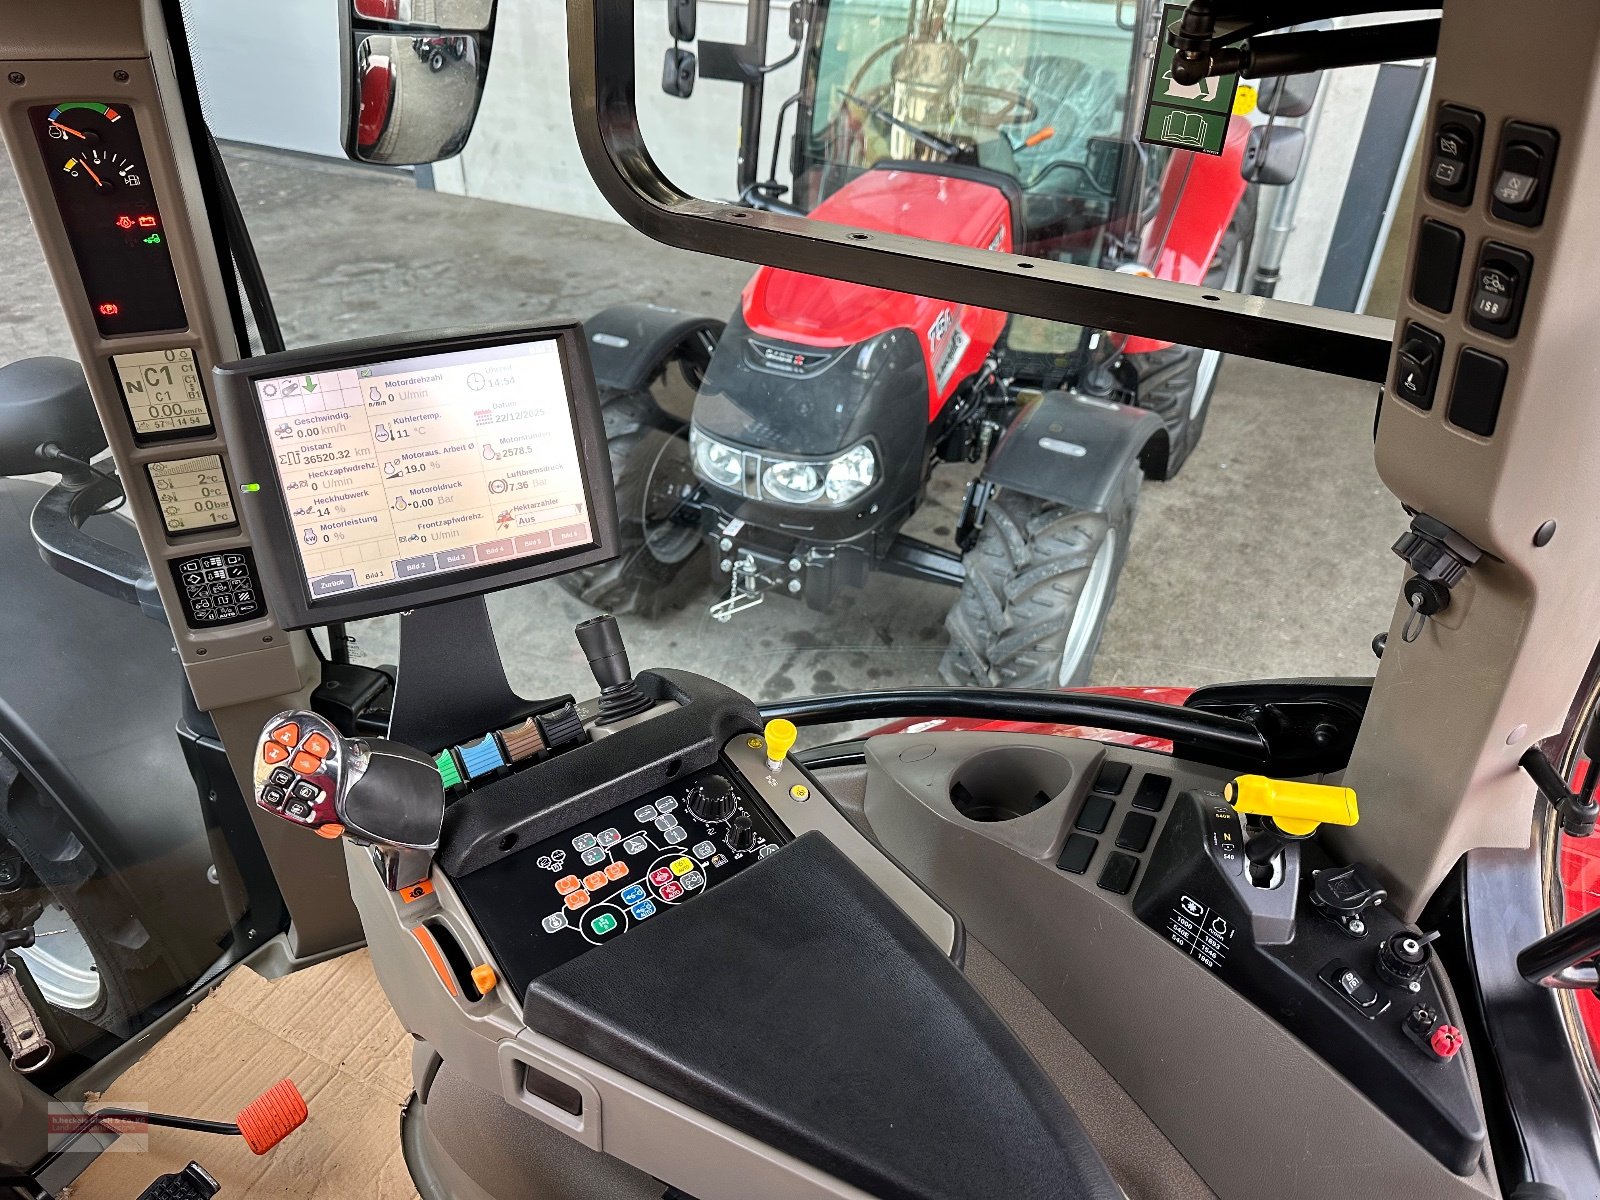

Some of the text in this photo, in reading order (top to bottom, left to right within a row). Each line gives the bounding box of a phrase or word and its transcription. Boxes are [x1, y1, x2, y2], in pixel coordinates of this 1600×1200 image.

[164, 350, 175, 361] 0
[181, 364, 194, 373] C1
[144, 365, 173, 387] C1
[184, 376, 196, 384] C1
[385, 374, 443, 388] Motordrehzahl
[125, 380, 144, 394] N
[155, 391, 172, 402] C1
[188, 391, 201, 399] B1
[388, 389, 428, 402] 0 U/min
[149, 403, 183, 418] 0.00
[495, 408, 545, 423] 22/12/2025
[294, 412, 351, 426] Geschwindig.
[297, 423, 347, 438] 0.00 km/h
[397, 430, 410, 439] 11
[300, 442, 332, 453] Distanz
[401, 449, 441, 461] Motoraus.
[443, 444, 466, 454] Arbeit
[502, 445, 533, 458] 2578.5
[304, 447, 371, 465] 36520.32 km
[405, 463, 426, 475] 19.0
[506, 463, 563, 479] Luftbremsdruck
[312, 477, 353, 491] 0 U/min
[509, 481, 529, 491] 7.36
[313, 490, 369, 505] Heckhubwerk
[413, 495, 454, 509] 0.00 Bar
[320, 515, 378, 531] Motorleistung
[518, 516, 536, 525] Aus
[431, 529, 460, 541] U/min
[447, 555, 460, 563] Bild
[407, 563, 419, 571] Bild
[365, 572, 379, 580] Bild
[321, 578, 345, 589] Zurück
[1224, 833, 1231, 841] N
[1178, 916, 1193, 930] 1000
[1172, 934, 1184, 945] 540
